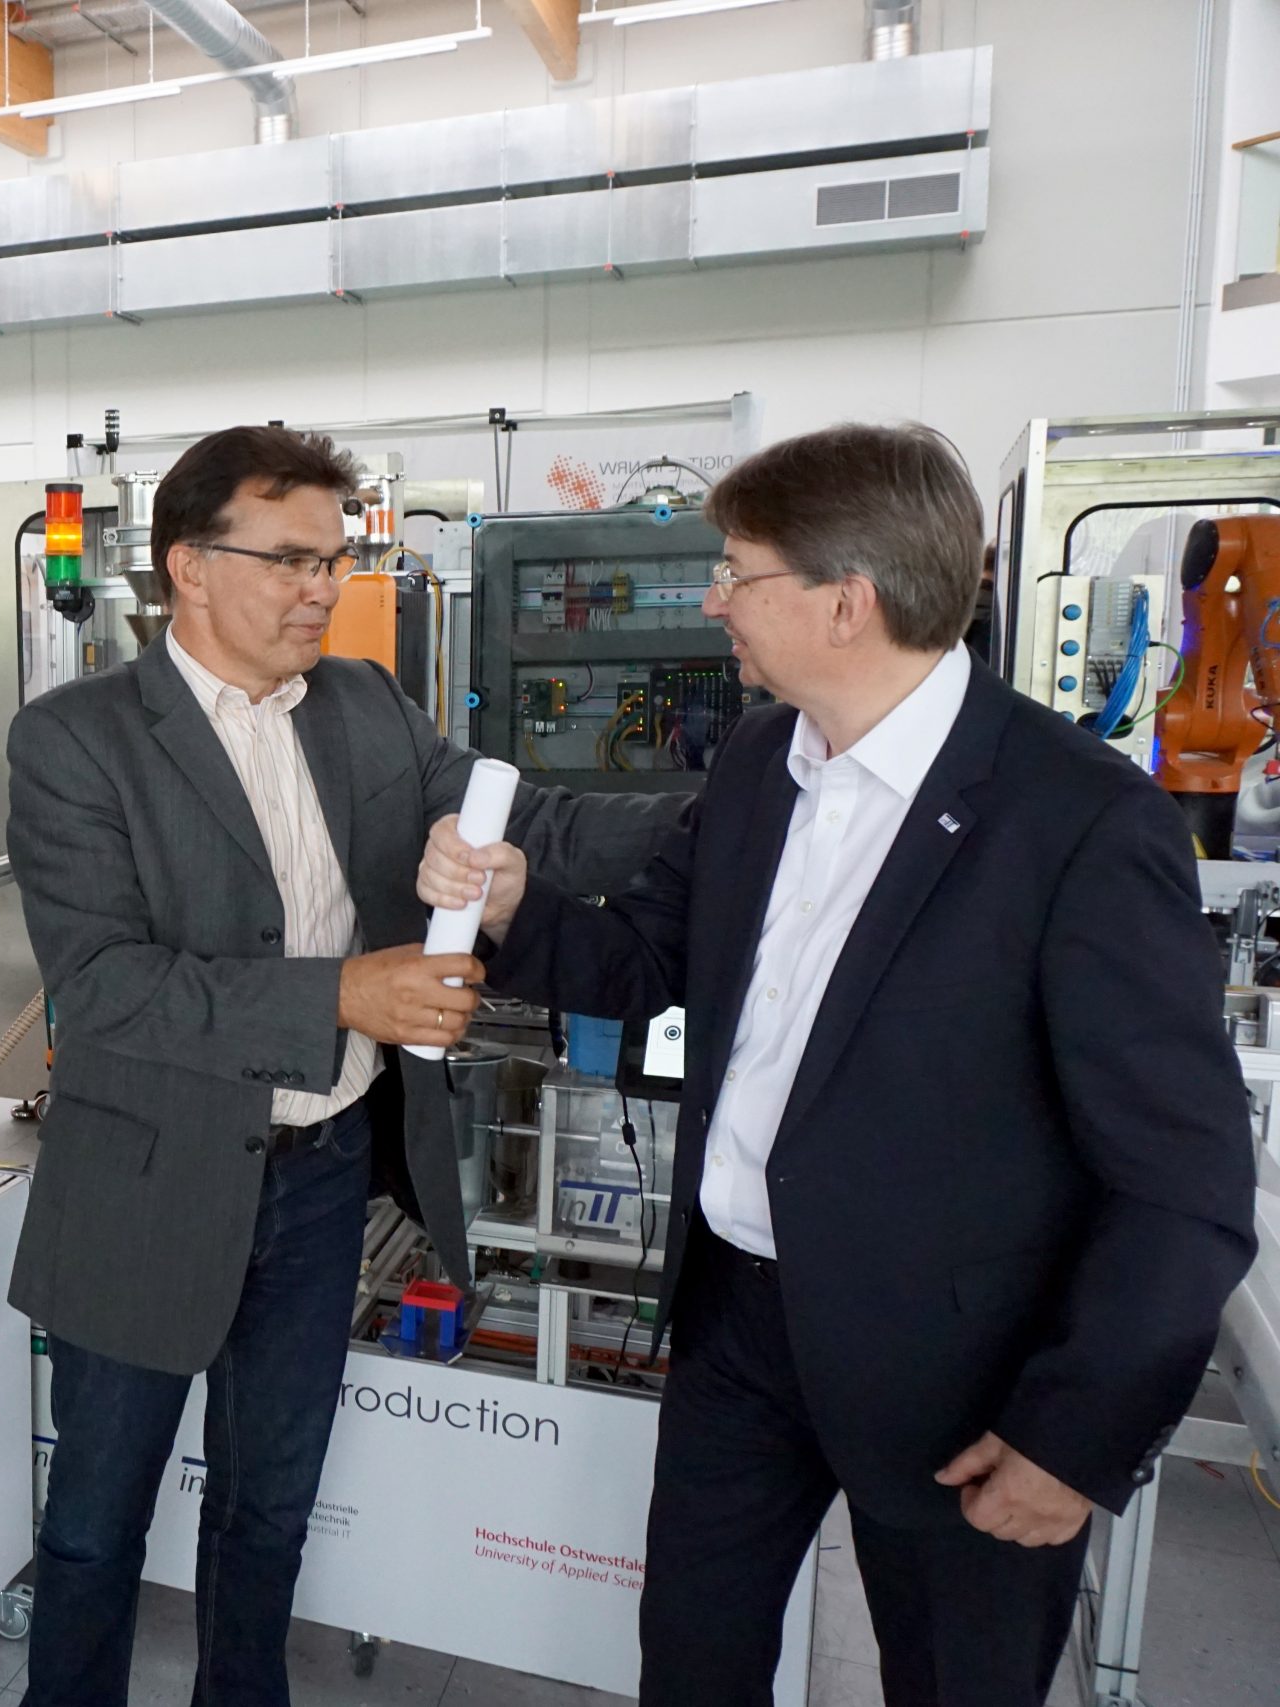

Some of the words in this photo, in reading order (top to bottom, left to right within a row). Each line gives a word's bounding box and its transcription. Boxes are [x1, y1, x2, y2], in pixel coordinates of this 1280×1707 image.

[1206, 664, 1218, 710] KUKA
[340, 1383, 559, 1446] roduction
[315, 1499, 359, 1516] dustrielle
[475, 1526, 556, 1554] Hochschule
[559, 1544, 646, 1573] Ostwestfale
[475, 1544, 538, 1571] University
[541, 1559, 556, 1575] of
[558, 1562, 609, 1584] Applied
